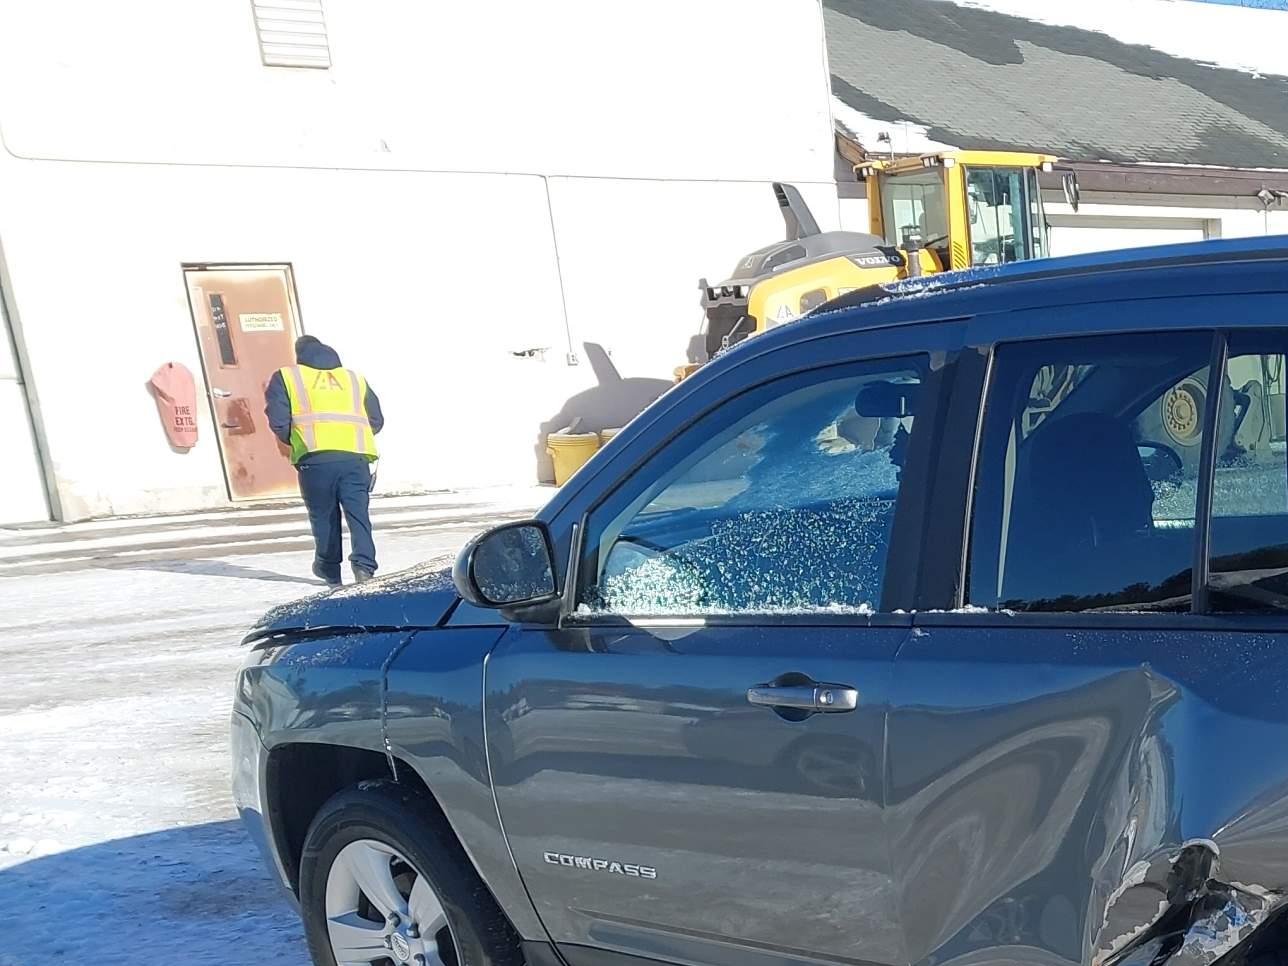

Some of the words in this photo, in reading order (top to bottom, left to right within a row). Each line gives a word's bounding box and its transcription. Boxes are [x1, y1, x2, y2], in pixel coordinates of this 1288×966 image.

[855, 254, 901, 266] VOLVO
[174, 406, 191, 415] FIRE
[543, 850, 657, 880] COMPASS
